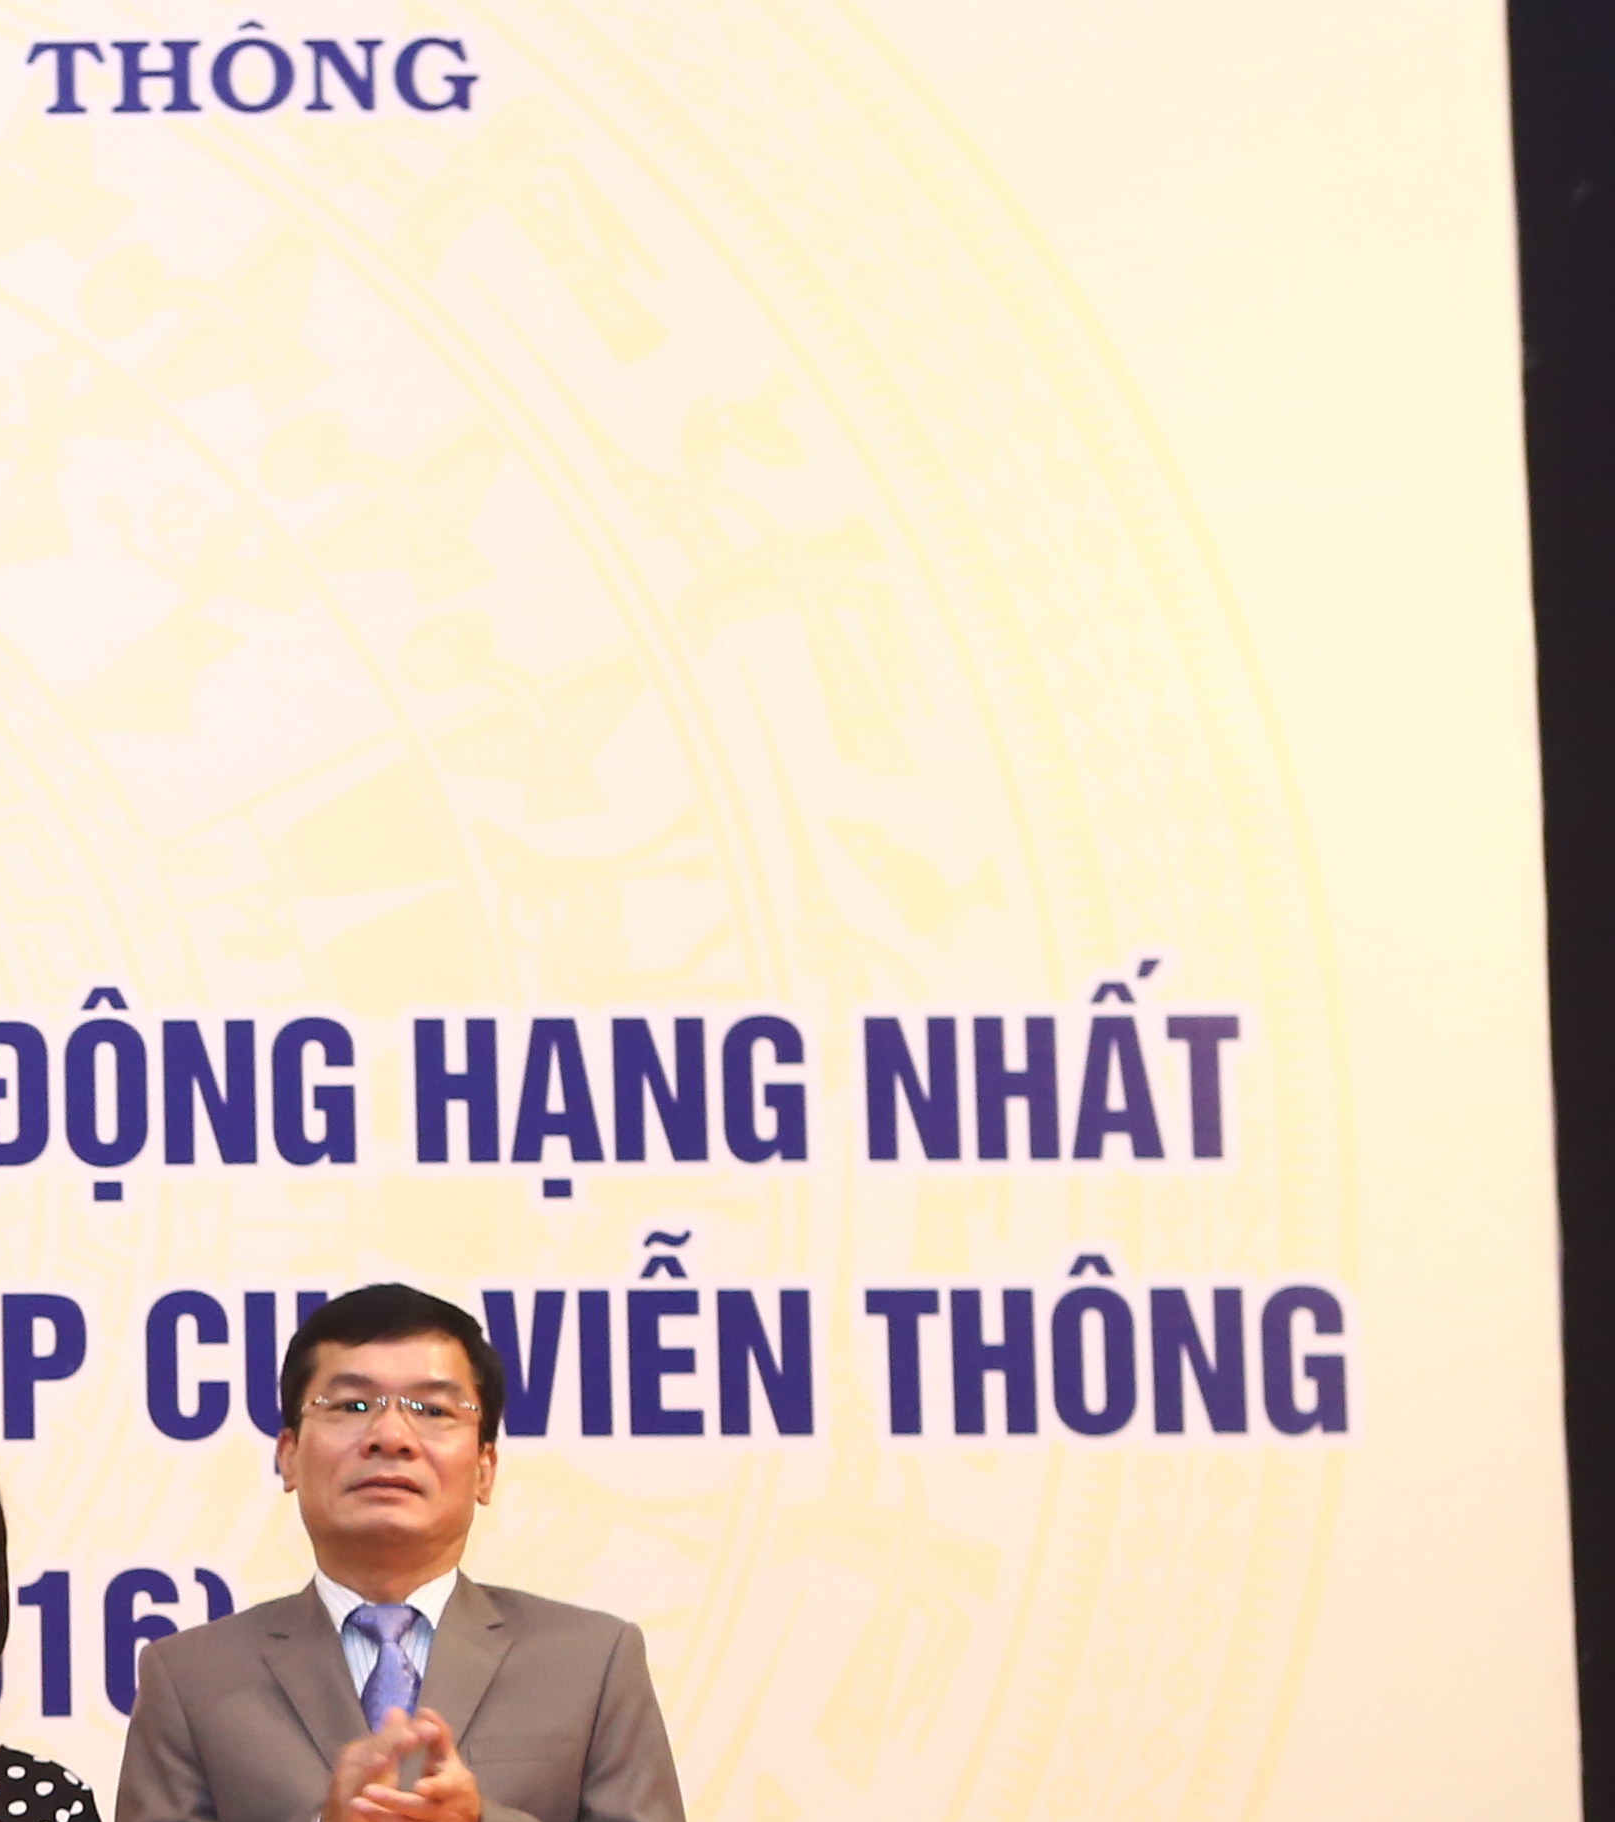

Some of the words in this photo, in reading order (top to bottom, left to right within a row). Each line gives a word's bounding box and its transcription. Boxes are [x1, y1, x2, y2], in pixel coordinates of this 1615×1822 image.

[24, 18, 480, 118] THÔNG
[410, 1013, 809, 1200] HẠNG
[860, 958, 1242, 1165] NHẤT
[142, 1287, 332, 1476] CỤ
[478, 1229, 816, 1441] VIỄN
[860, 1254, 1351, 1438] THÔNG
